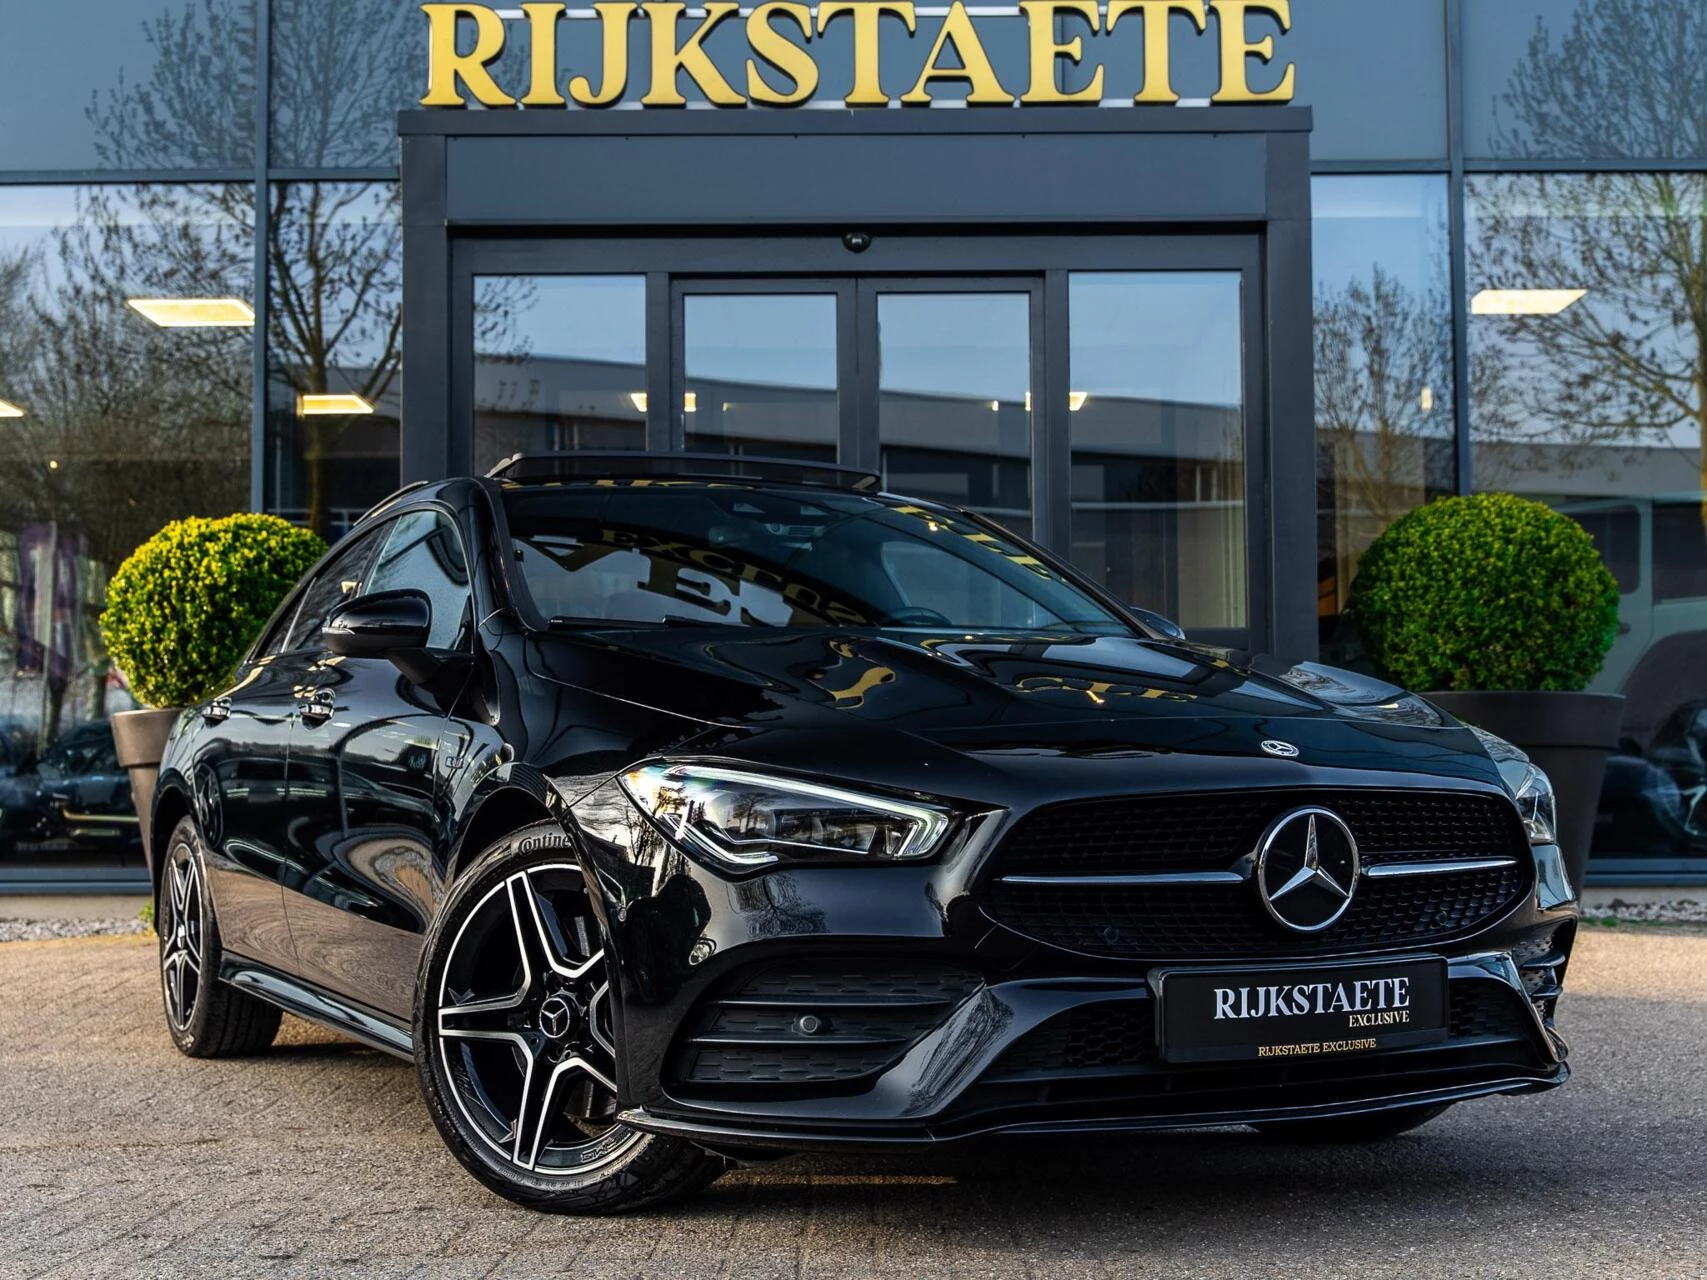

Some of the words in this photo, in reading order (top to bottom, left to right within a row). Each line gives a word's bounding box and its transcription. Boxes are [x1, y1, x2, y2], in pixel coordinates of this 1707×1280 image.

[421, 1, 1295, 107] RIJKSTAETE
[1213, 977, 1410, 1019] RIJKSTAETE
[1349, 1010, 1410, 1027] EXCLUSIVE
[1258, 1043, 1320, 1057] RIJKSTAETE
[1322, 1038, 1376, 1051] EXCLUSIVE
